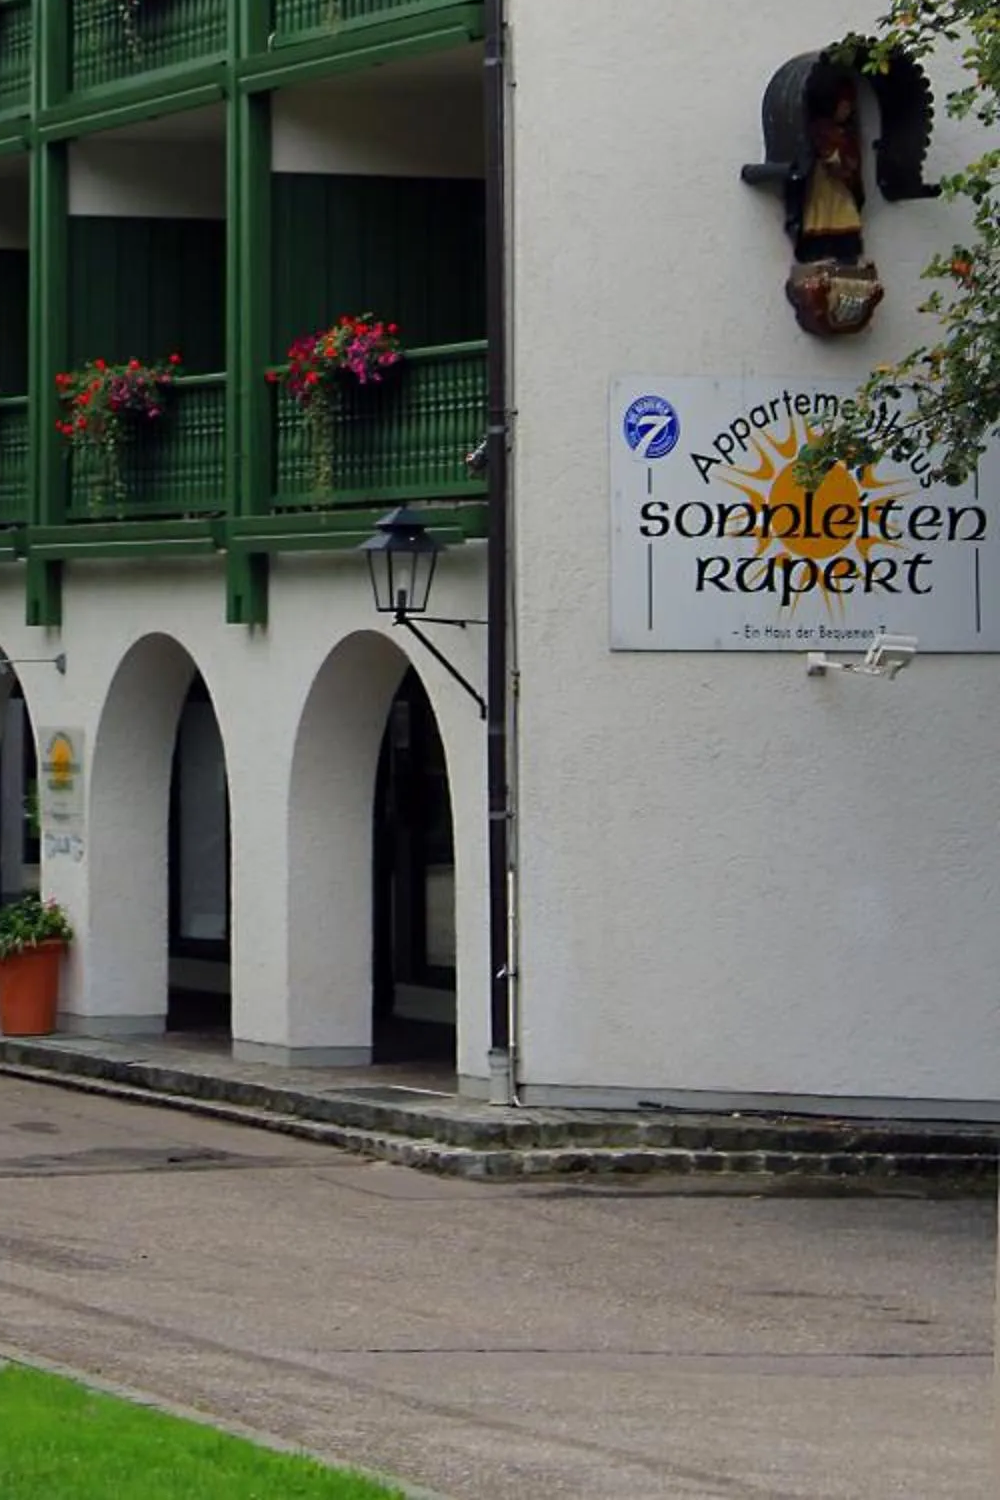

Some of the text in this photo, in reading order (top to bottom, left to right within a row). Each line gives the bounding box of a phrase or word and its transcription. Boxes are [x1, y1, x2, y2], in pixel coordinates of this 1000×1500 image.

[639, 415, 672, 458] 7
[764, 624, 792, 639] Haus
[795, 624, 814, 639] der
